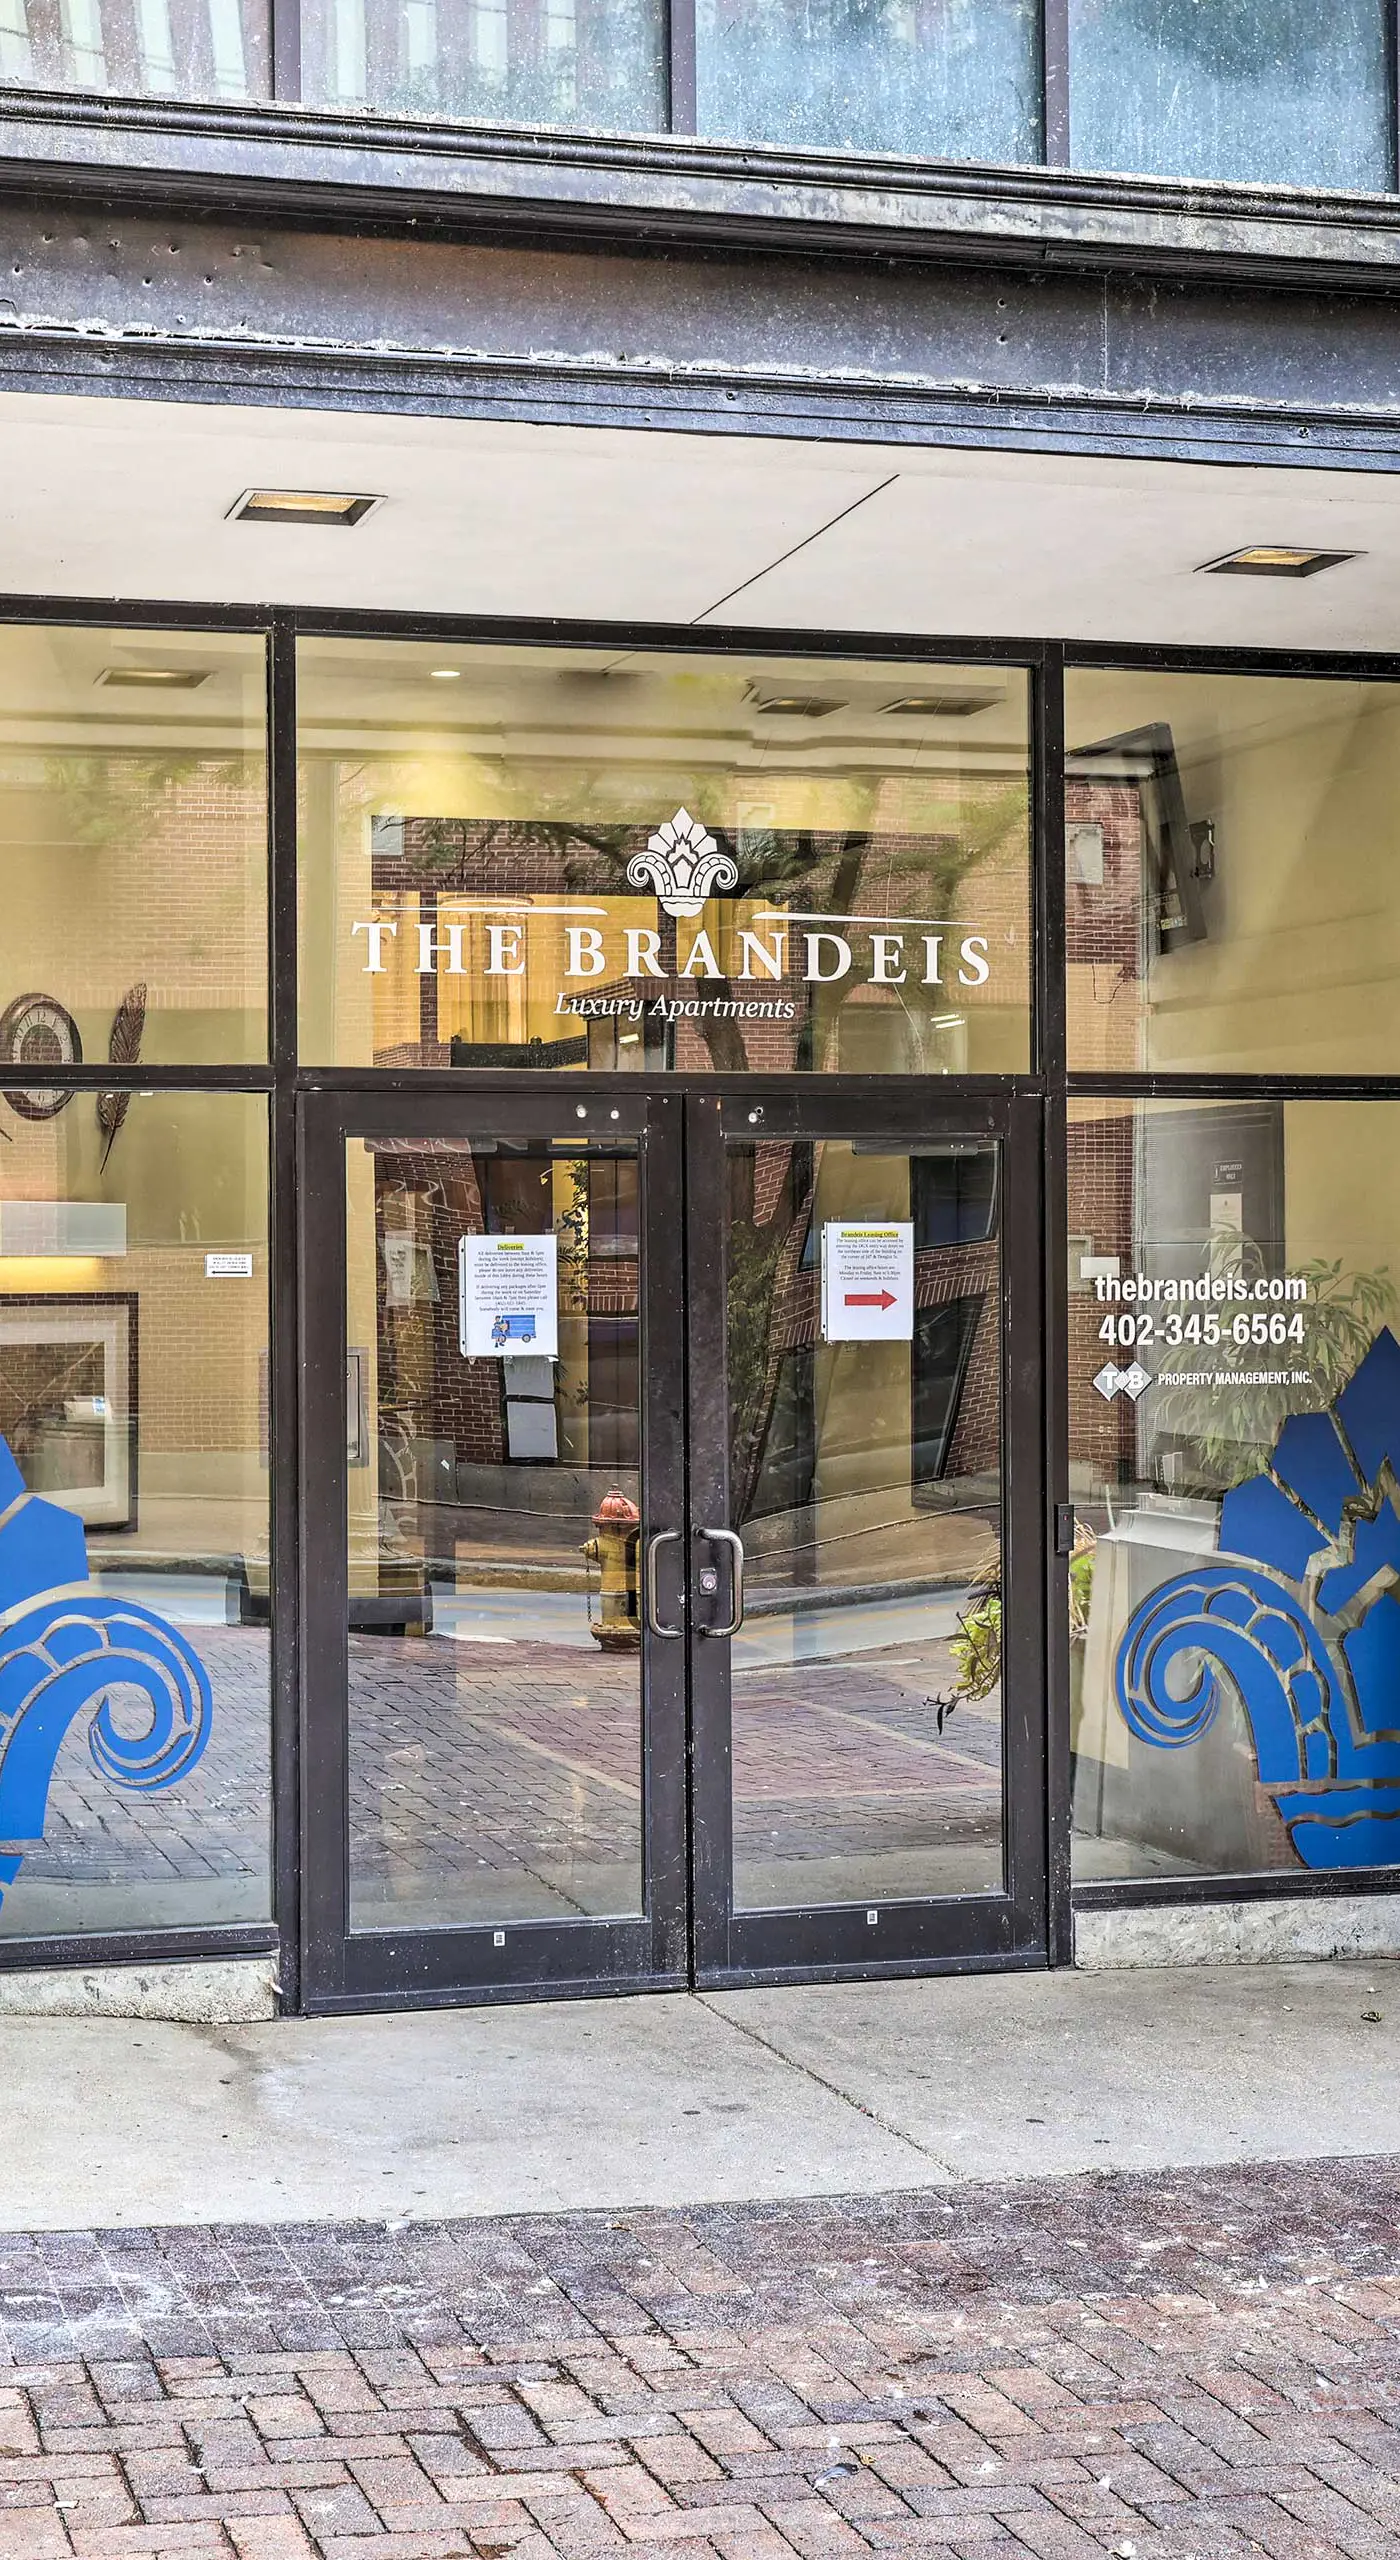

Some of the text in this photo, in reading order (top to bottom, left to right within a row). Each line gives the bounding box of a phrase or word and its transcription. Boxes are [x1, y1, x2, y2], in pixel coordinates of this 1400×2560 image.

[351, 921, 991, 986] THE BRANDEIS
[37, 1010, 46, 1023] 12
[553, 992, 796, 1023] Luxury Apartments
[1095, 1272, 1307, 1301] thebrandeis.com
[1098, 1313, 1306, 1346] 402-345-6564
[1157, 1373, 1214, 1386] PROPERTY
[1215, 1372, 1290, 1386] MANAGEMENT,
[1291, 1371, 1312, 1384] INC.
